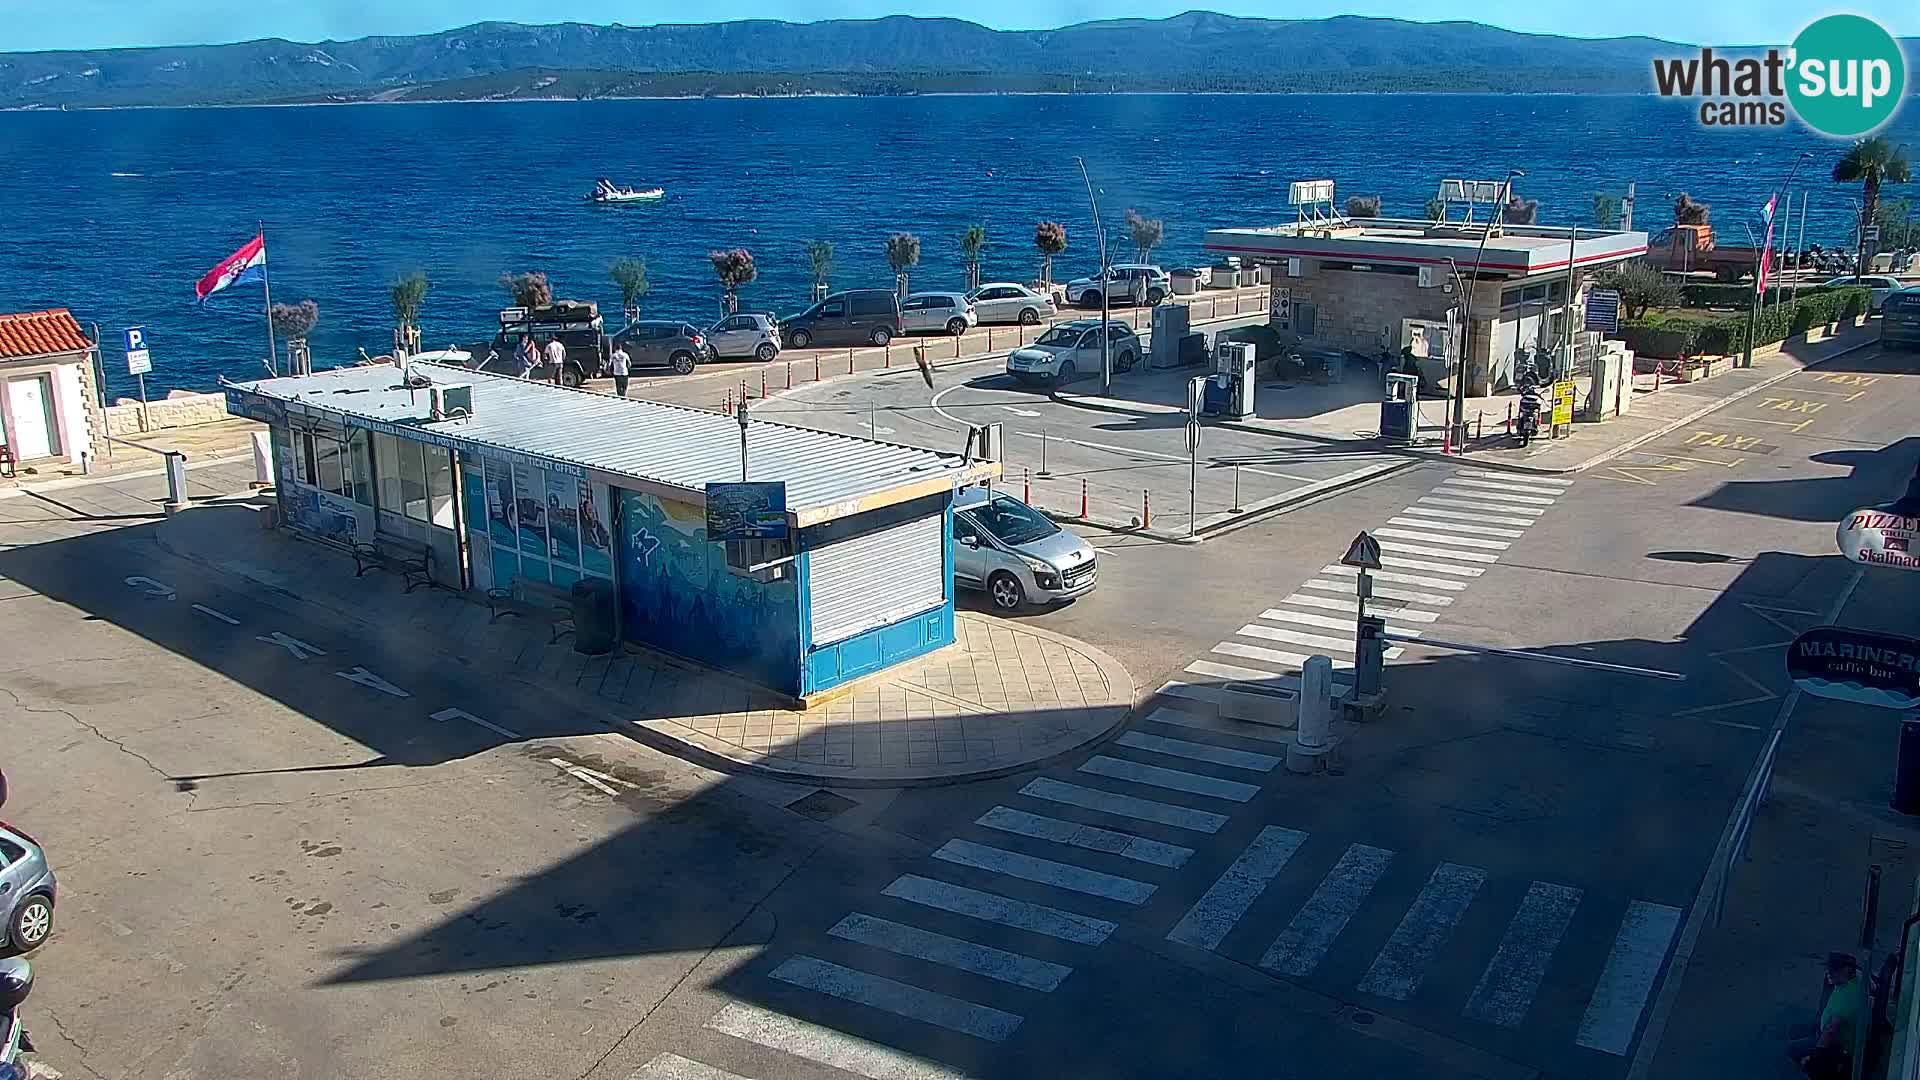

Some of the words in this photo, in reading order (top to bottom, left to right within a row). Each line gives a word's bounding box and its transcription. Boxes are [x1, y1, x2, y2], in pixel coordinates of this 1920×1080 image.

[128, 330, 142, 349] P
[1813, 373, 1879, 387] TAXI
[1756, 398, 1828, 414] TAXI
[1684, 432, 1763, 450] TAXI
[528, 456, 554, 471] TICKET
[554, 463, 581, 476] OFFICE
[1870, 664, 1896, 678] bar
